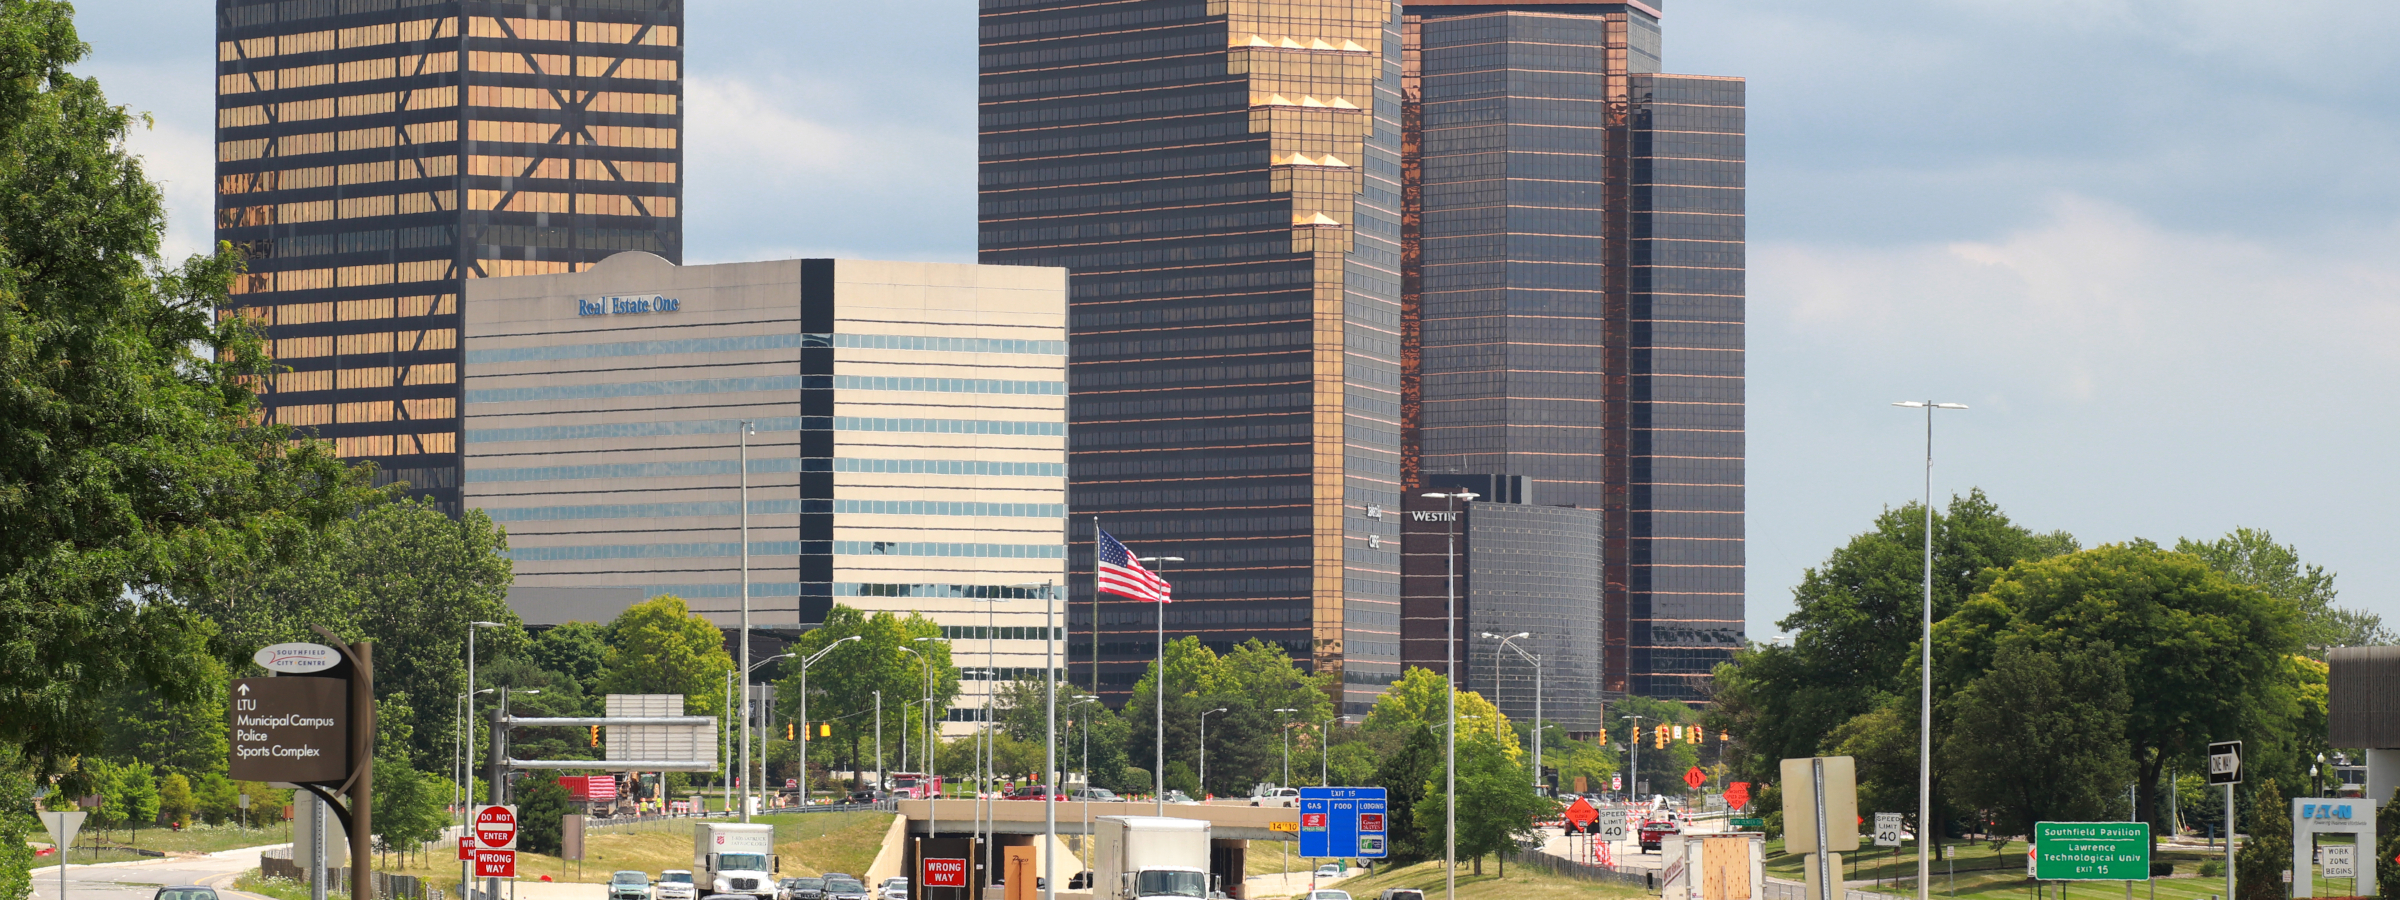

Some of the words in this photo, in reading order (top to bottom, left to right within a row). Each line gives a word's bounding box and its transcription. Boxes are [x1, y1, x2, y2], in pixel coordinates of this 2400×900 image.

[578, 296, 607, 315] Real
[612, 297, 650, 314] Estate
[653, 296, 679, 312] One
[1412, 511, 1456, 522] WESTIN
[237, 699, 257, 711] LTU
[237, 713, 289, 729] Municipal
[290, 714, 334, 729] Campus
[237, 728, 268, 741] Police
[237, 745, 270, 760] Sports
[272, 744, 320, 760] Complex
[2212, 756, 2222, 772] ONE
[2222, 755, 2232, 771] WAY
[481, 813, 492, 821] DO
[484, 832, 508, 840] ENTER
[1605, 827, 1622, 836] 40
[1879, 831, 1896, 841] 40
[2045, 828, 2095, 836] Southfield
[2100, 828, 2141, 836] Pavilion
[2069, 844, 2116, 852] Lawrence
[480, 854, 512, 863] WRONG
[2044, 853, 2114, 863] Technological
[2119, 854, 2141, 862] Univ
[486, 864, 505, 873] WAY
[928, 862, 961, 872] WRONG
[2097, 866, 2109, 874] 15
[934, 873, 954, 882] WAY
